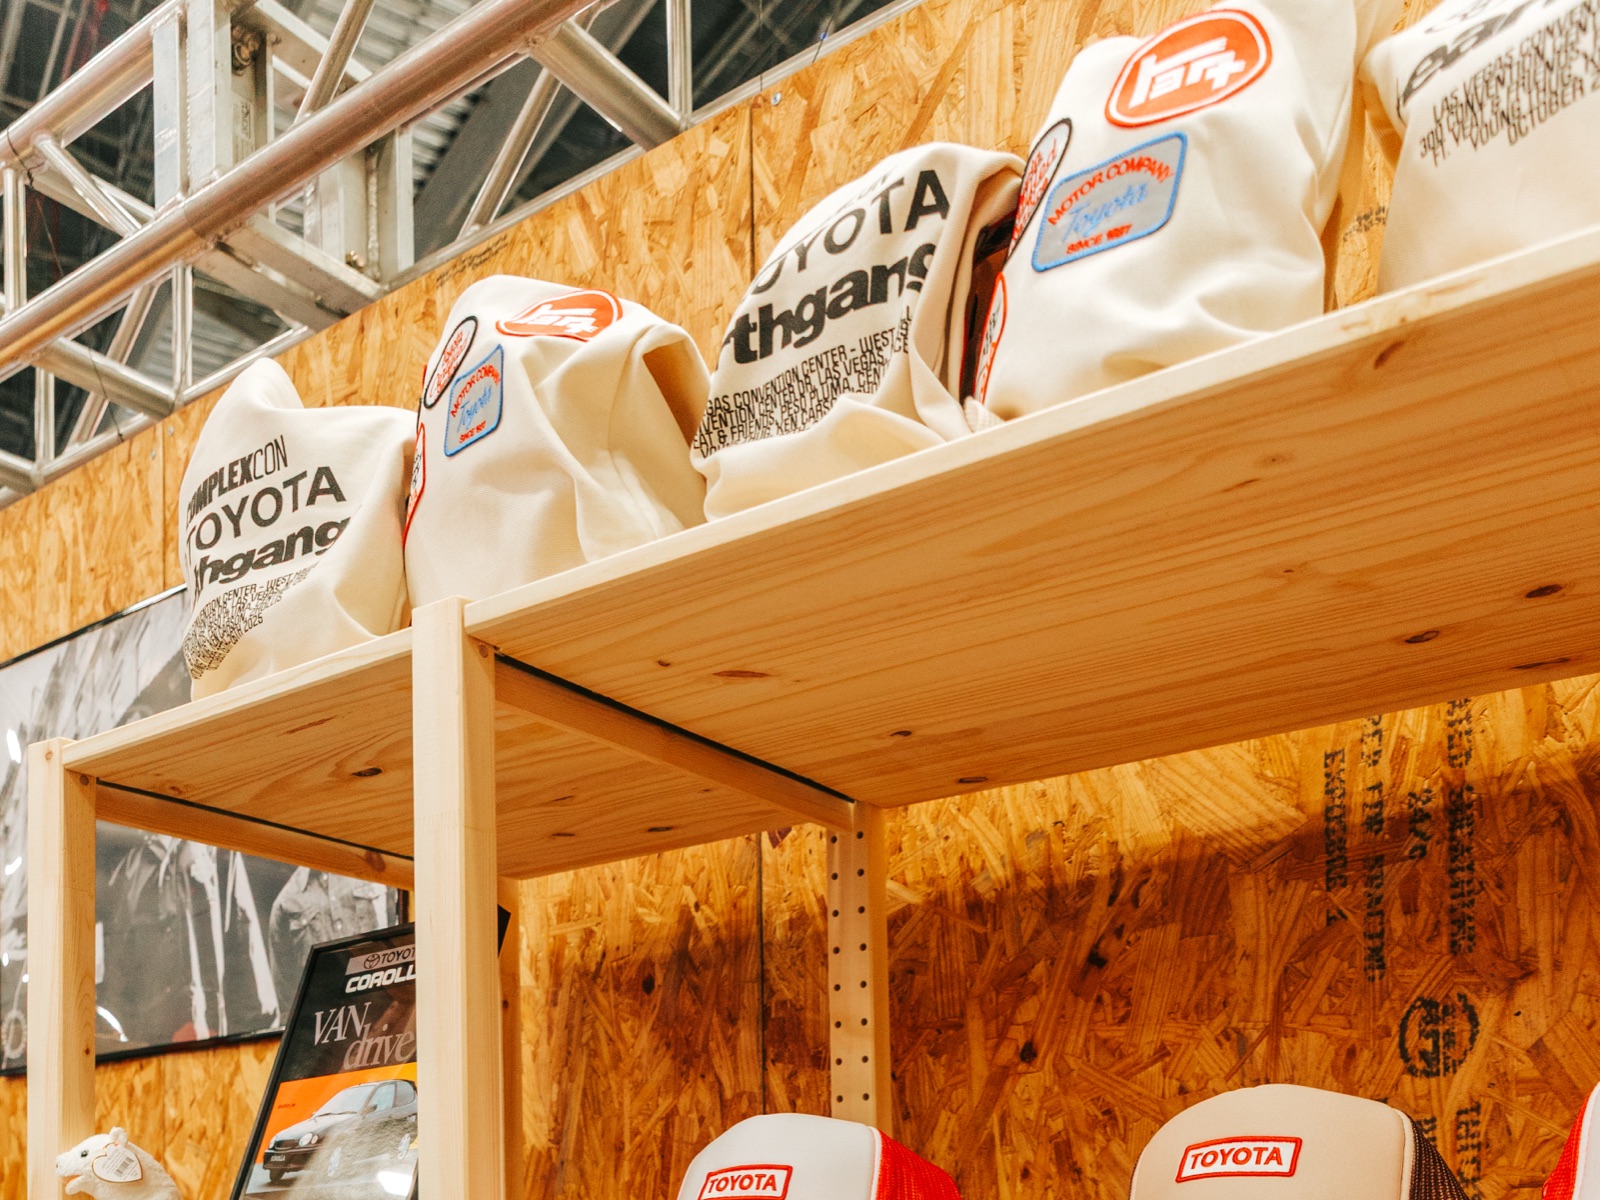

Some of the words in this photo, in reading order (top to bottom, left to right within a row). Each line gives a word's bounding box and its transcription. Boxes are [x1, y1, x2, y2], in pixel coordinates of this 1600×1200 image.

[1048, 171, 1104, 225] MOTOR
[1106, 156, 1174, 184] COMPANY
[1061, 182, 1148, 242] Toyota
[1066, 234, 1103, 255] SINCE
[733, 365, 800, 407] CONVENTION
[801, 345, 847, 378] CENTER
[859, 327, 895, 356] WEST
[817, 360, 841, 386] LAS
[451, 375, 476, 418] MOTOR
[718, 427, 728, 445] &
[781, 395, 807, 418] PESO
[186, 434, 288, 528] COMPLEXCON
[187, 466, 347, 560] TOYOTA
[313, 1001, 372, 1046] VAN
[1190, 1146, 1283, 1169] TOYOTA
[708, 1173, 777, 1194] TOYOTA
